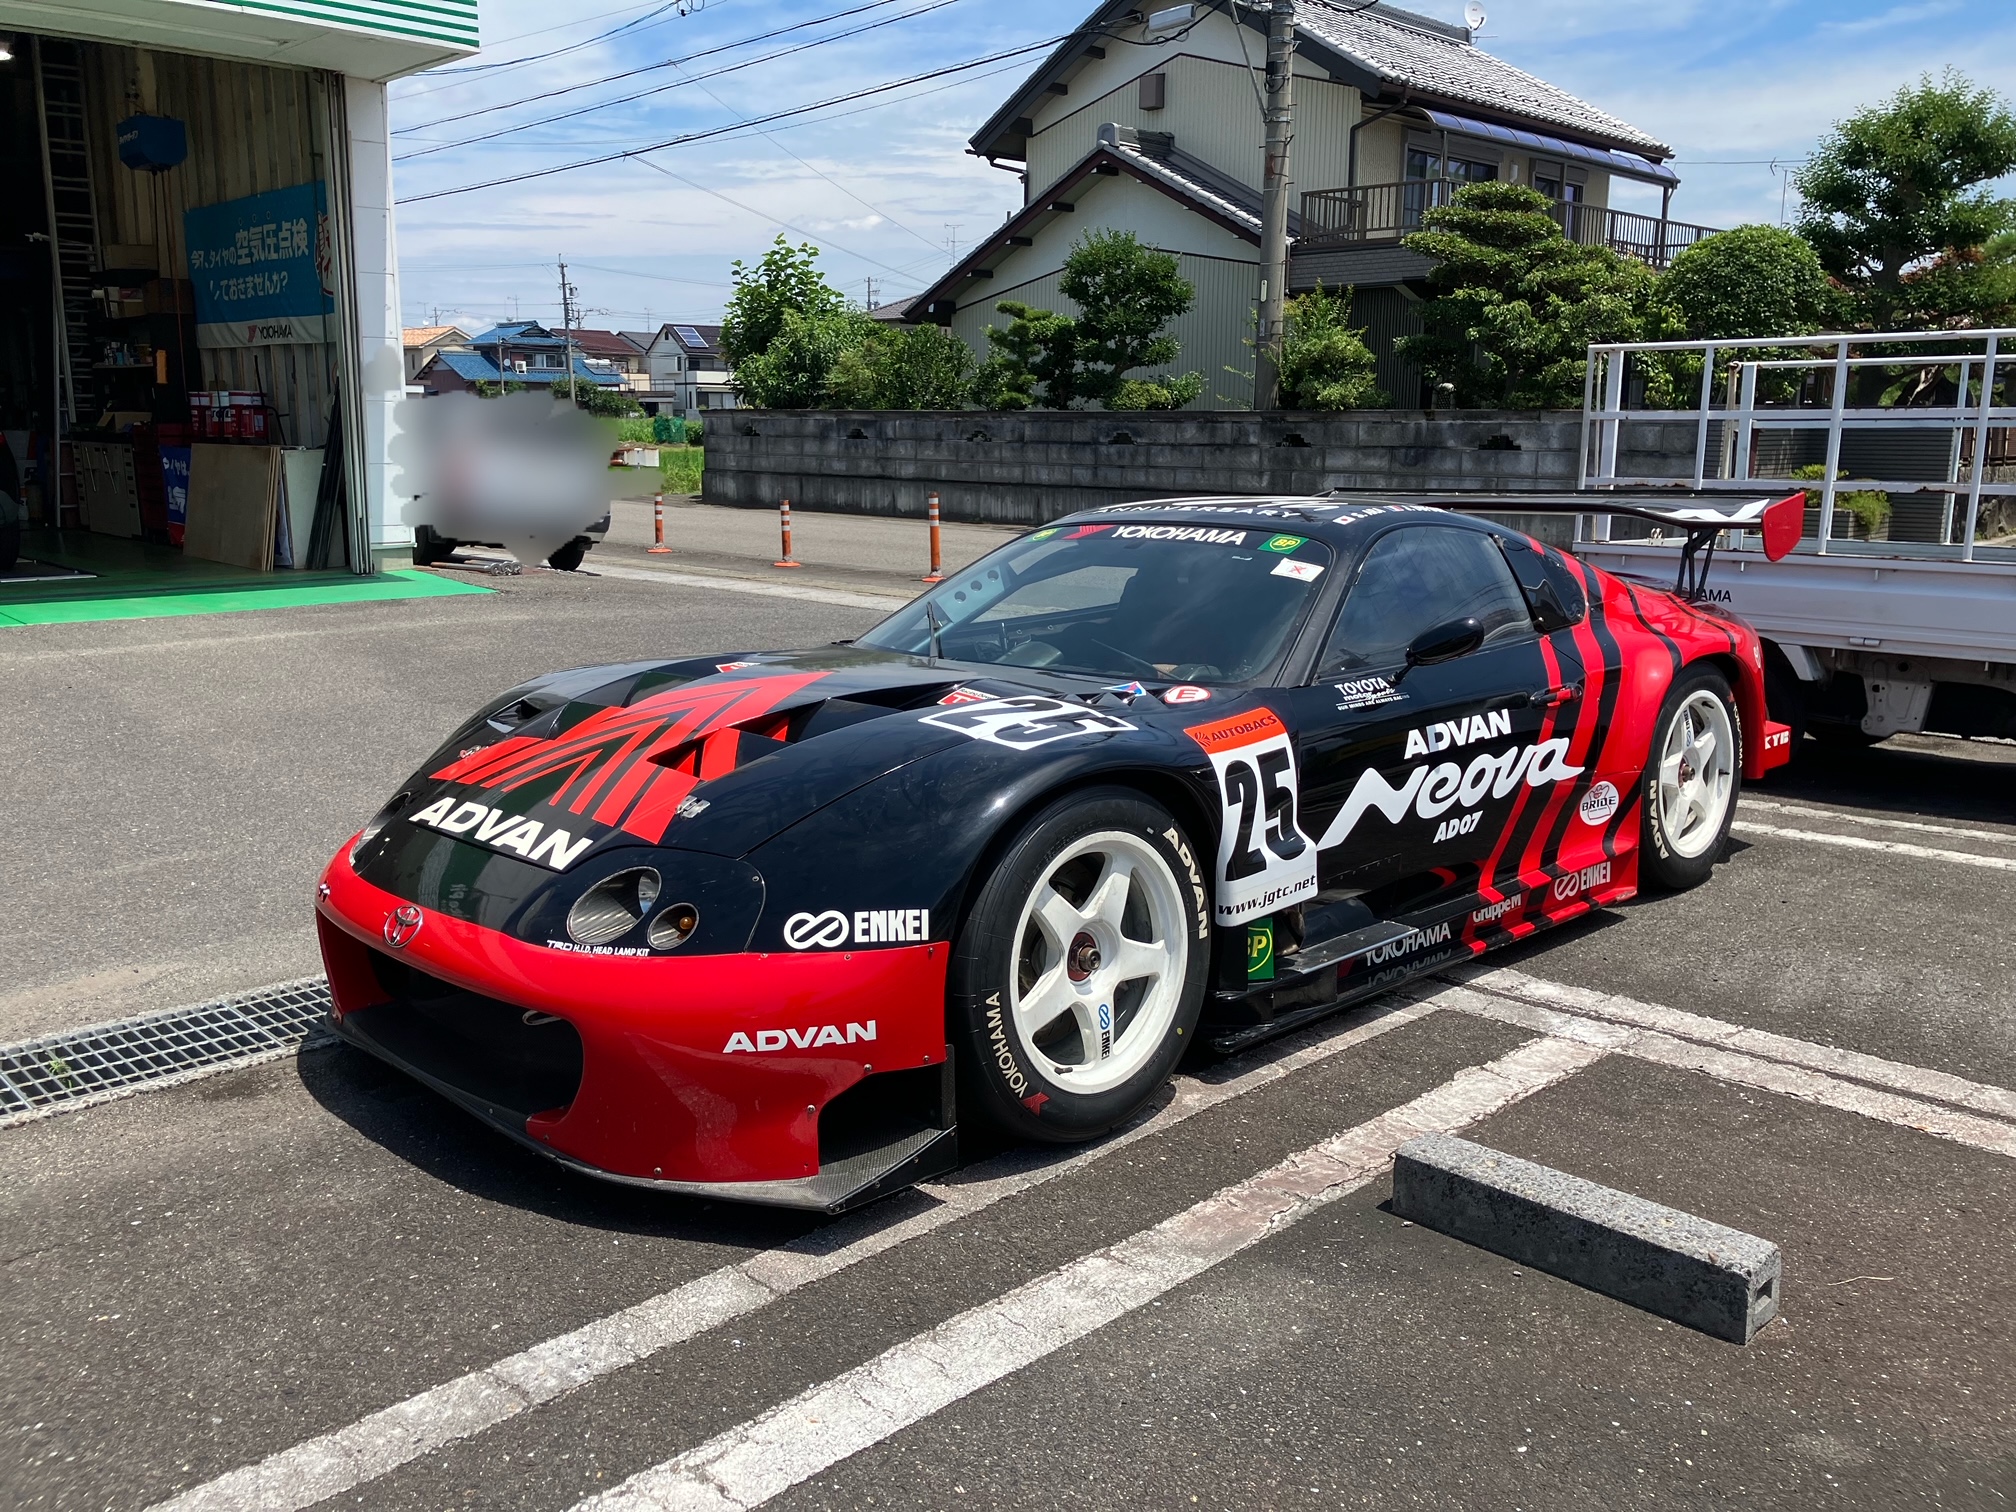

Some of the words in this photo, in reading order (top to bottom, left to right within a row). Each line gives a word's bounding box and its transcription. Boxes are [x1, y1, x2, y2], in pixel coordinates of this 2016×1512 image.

[257, 325, 293, 339] YOOHAMA
[1111, 525, 1248, 546] YOKOHAMA
[1272, 538, 1296, 548] BP
[1176, 689, 1198, 699] E
[1334, 677, 1390, 696] TOYOTA
[1343, 691, 1372, 701] motor
[1211, 715, 1278, 742] AUTOBACS
[1404, 709, 1512, 760] ADVAN
[1765, 731, 1789, 750] KYB
[1316, 737, 1586, 851] Neova
[1582, 796, 1616, 811] BRIDE
[1224, 746, 1307, 882] 25
[1433, 810, 1483, 843] AD07
[1649, 780, 1670, 860] ADVAN
[408, 796, 594, 870] ADVAN
[1163, 826, 1208, 940] ADVAN
[1581, 861, 1611, 891] ENKEI
[1218, 875, 1316, 915] www.jgtc.net
[854, 909, 929, 943] ENKEI
[547, 940, 573, 951] TRD
[573, 944, 591, 954] H.I.D.
[592, 946, 613, 955] HEAD
[614, 947, 636, 956] LAMP
[636, 948, 650, 957] KIT
[1248, 936, 1267, 957] P
[1365, 922, 1451, 967] YOKOHAMA
[722, 1020, 877, 1053] ADVAN
[985, 991, 1029, 1098] YOKOHAMA
[1100, 1029, 1111, 1061] ENKEI
